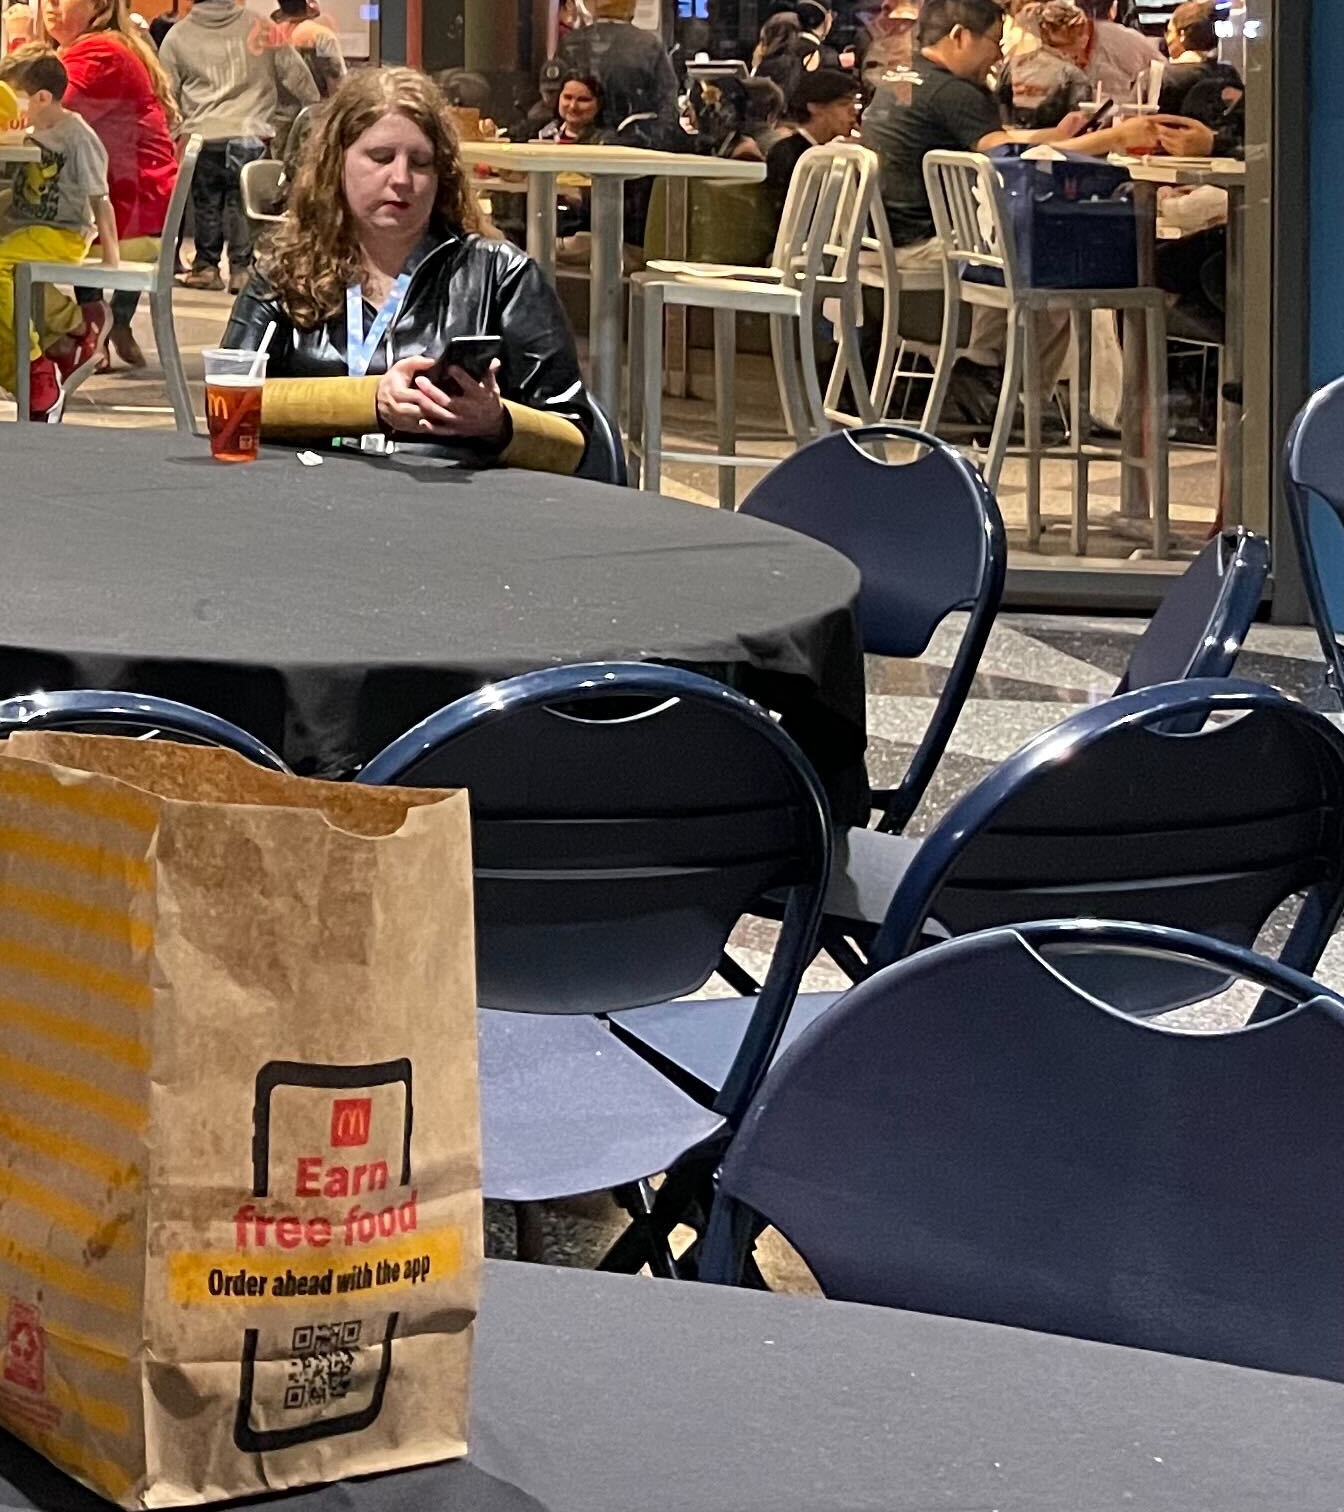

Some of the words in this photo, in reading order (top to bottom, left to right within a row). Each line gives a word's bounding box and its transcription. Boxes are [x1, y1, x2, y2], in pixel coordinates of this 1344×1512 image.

[294, 1155, 389, 1199] Earn
[232, 1203, 333, 1251] free
[343, 1189, 419, 1247] food
[207, 1267, 269, 1298] Order
[270, 1268, 334, 1298] ahead
[335, 1261, 374, 1295] with
[374, 1258, 401, 1287] the
[403, 1253, 432, 1286] app
